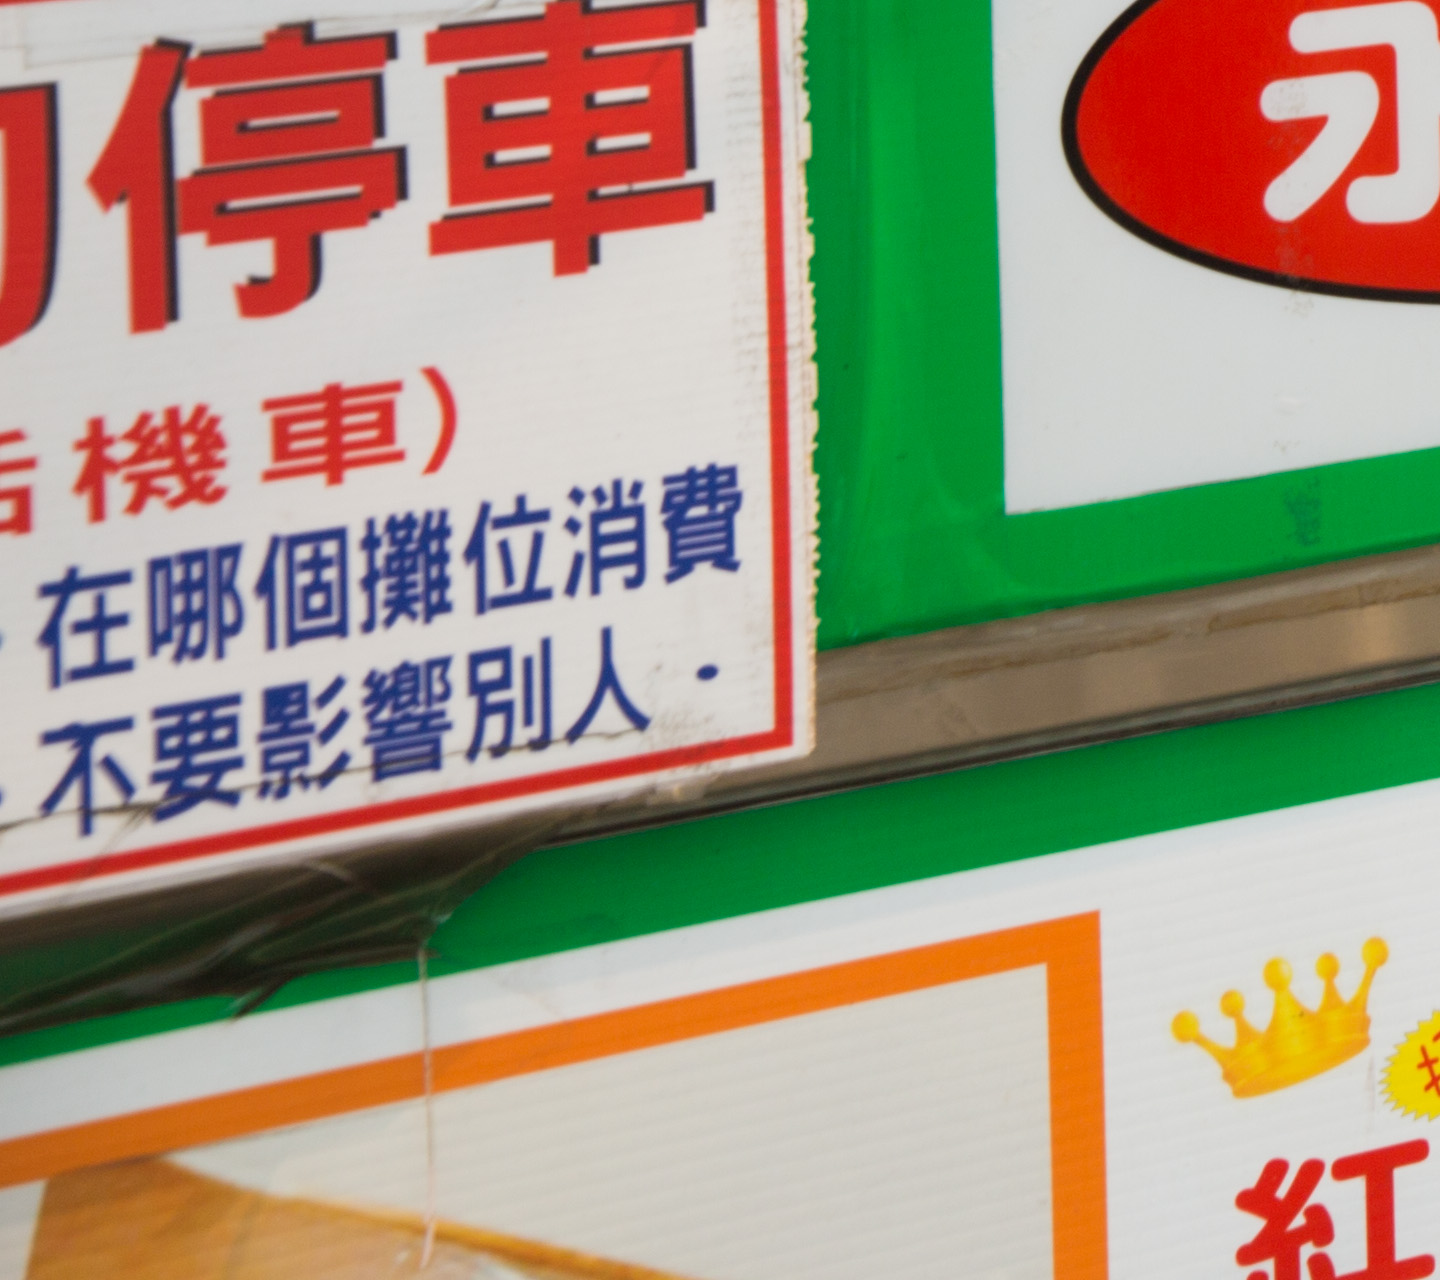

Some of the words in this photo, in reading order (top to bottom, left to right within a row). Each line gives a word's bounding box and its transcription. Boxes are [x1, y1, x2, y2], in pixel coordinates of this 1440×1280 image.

[36, 462, 746, 690] 在哪個攤位消費
